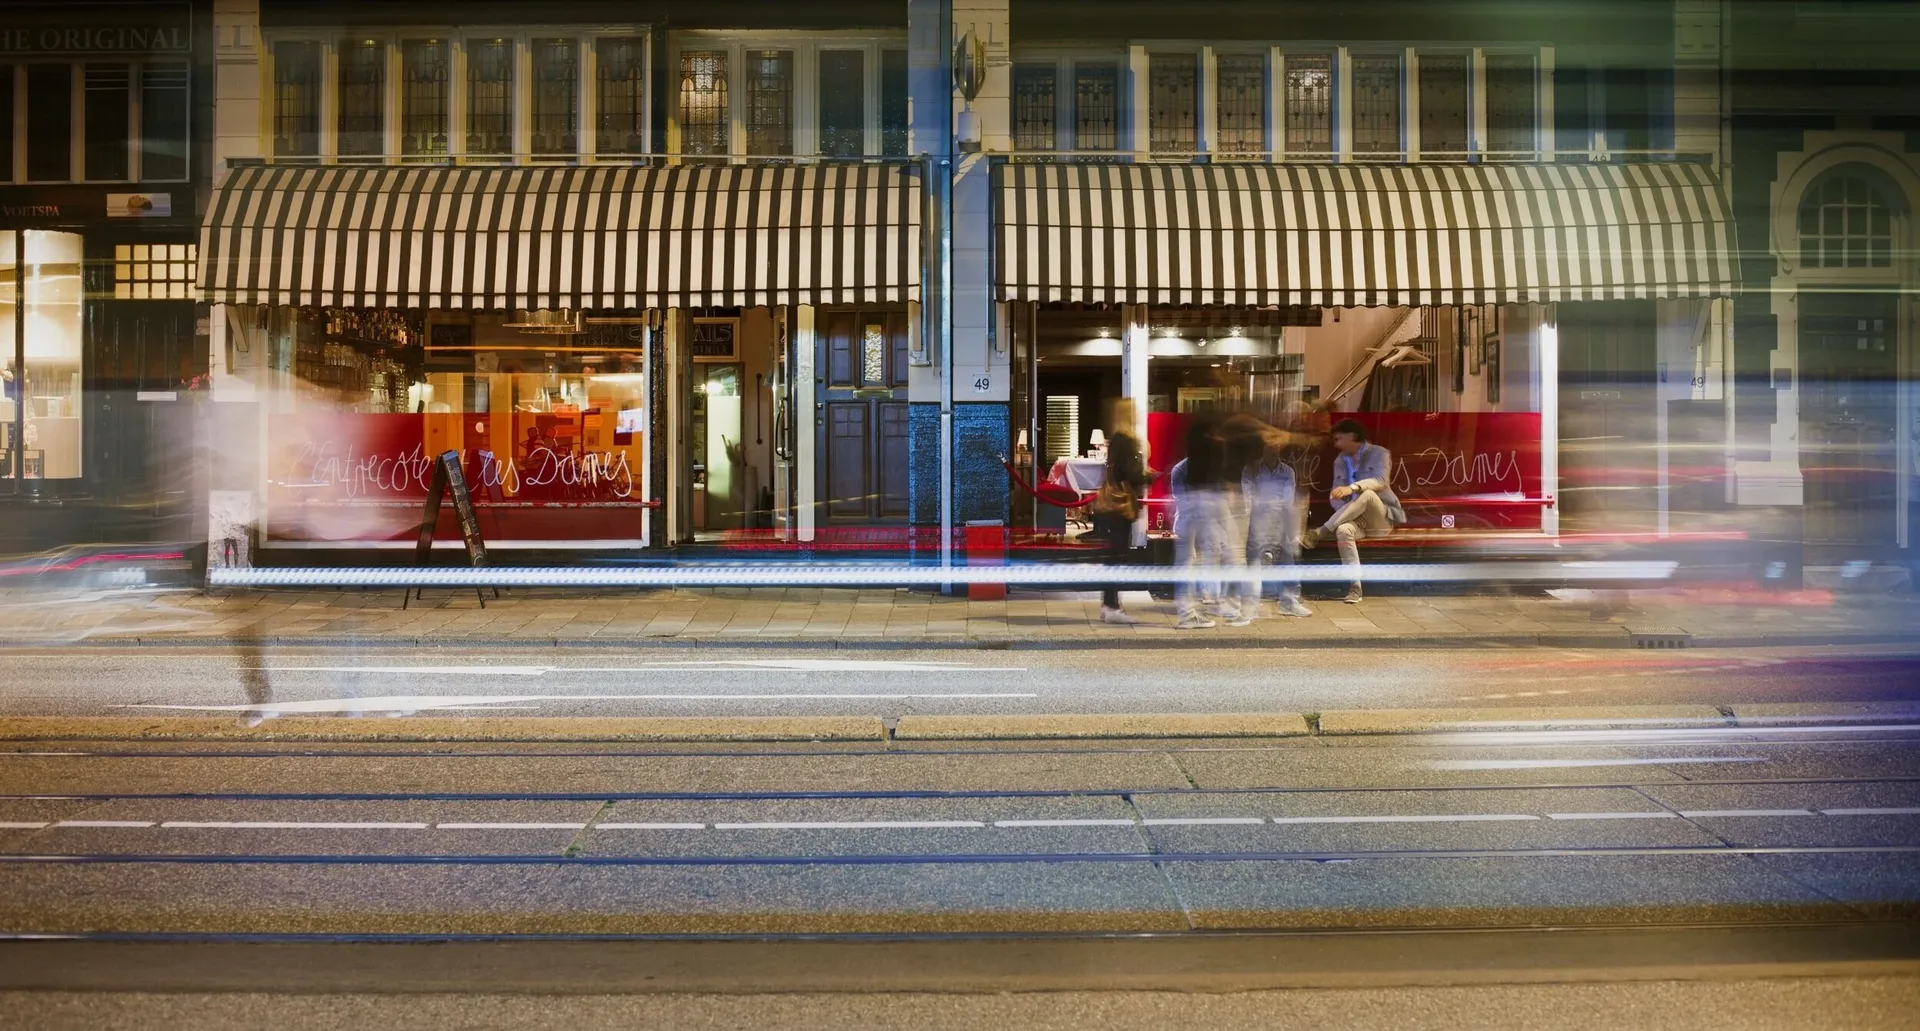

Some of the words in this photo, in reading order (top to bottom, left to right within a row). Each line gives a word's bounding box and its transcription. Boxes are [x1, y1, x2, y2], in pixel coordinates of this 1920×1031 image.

[40, 28, 188, 50] ORIGINAL
[4, 206, 60, 216] VOETSPA
[975, 378, 989, 390] 49
[525, 447, 632, 498] Dames
[1416, 447, 1523, 497] Dames
